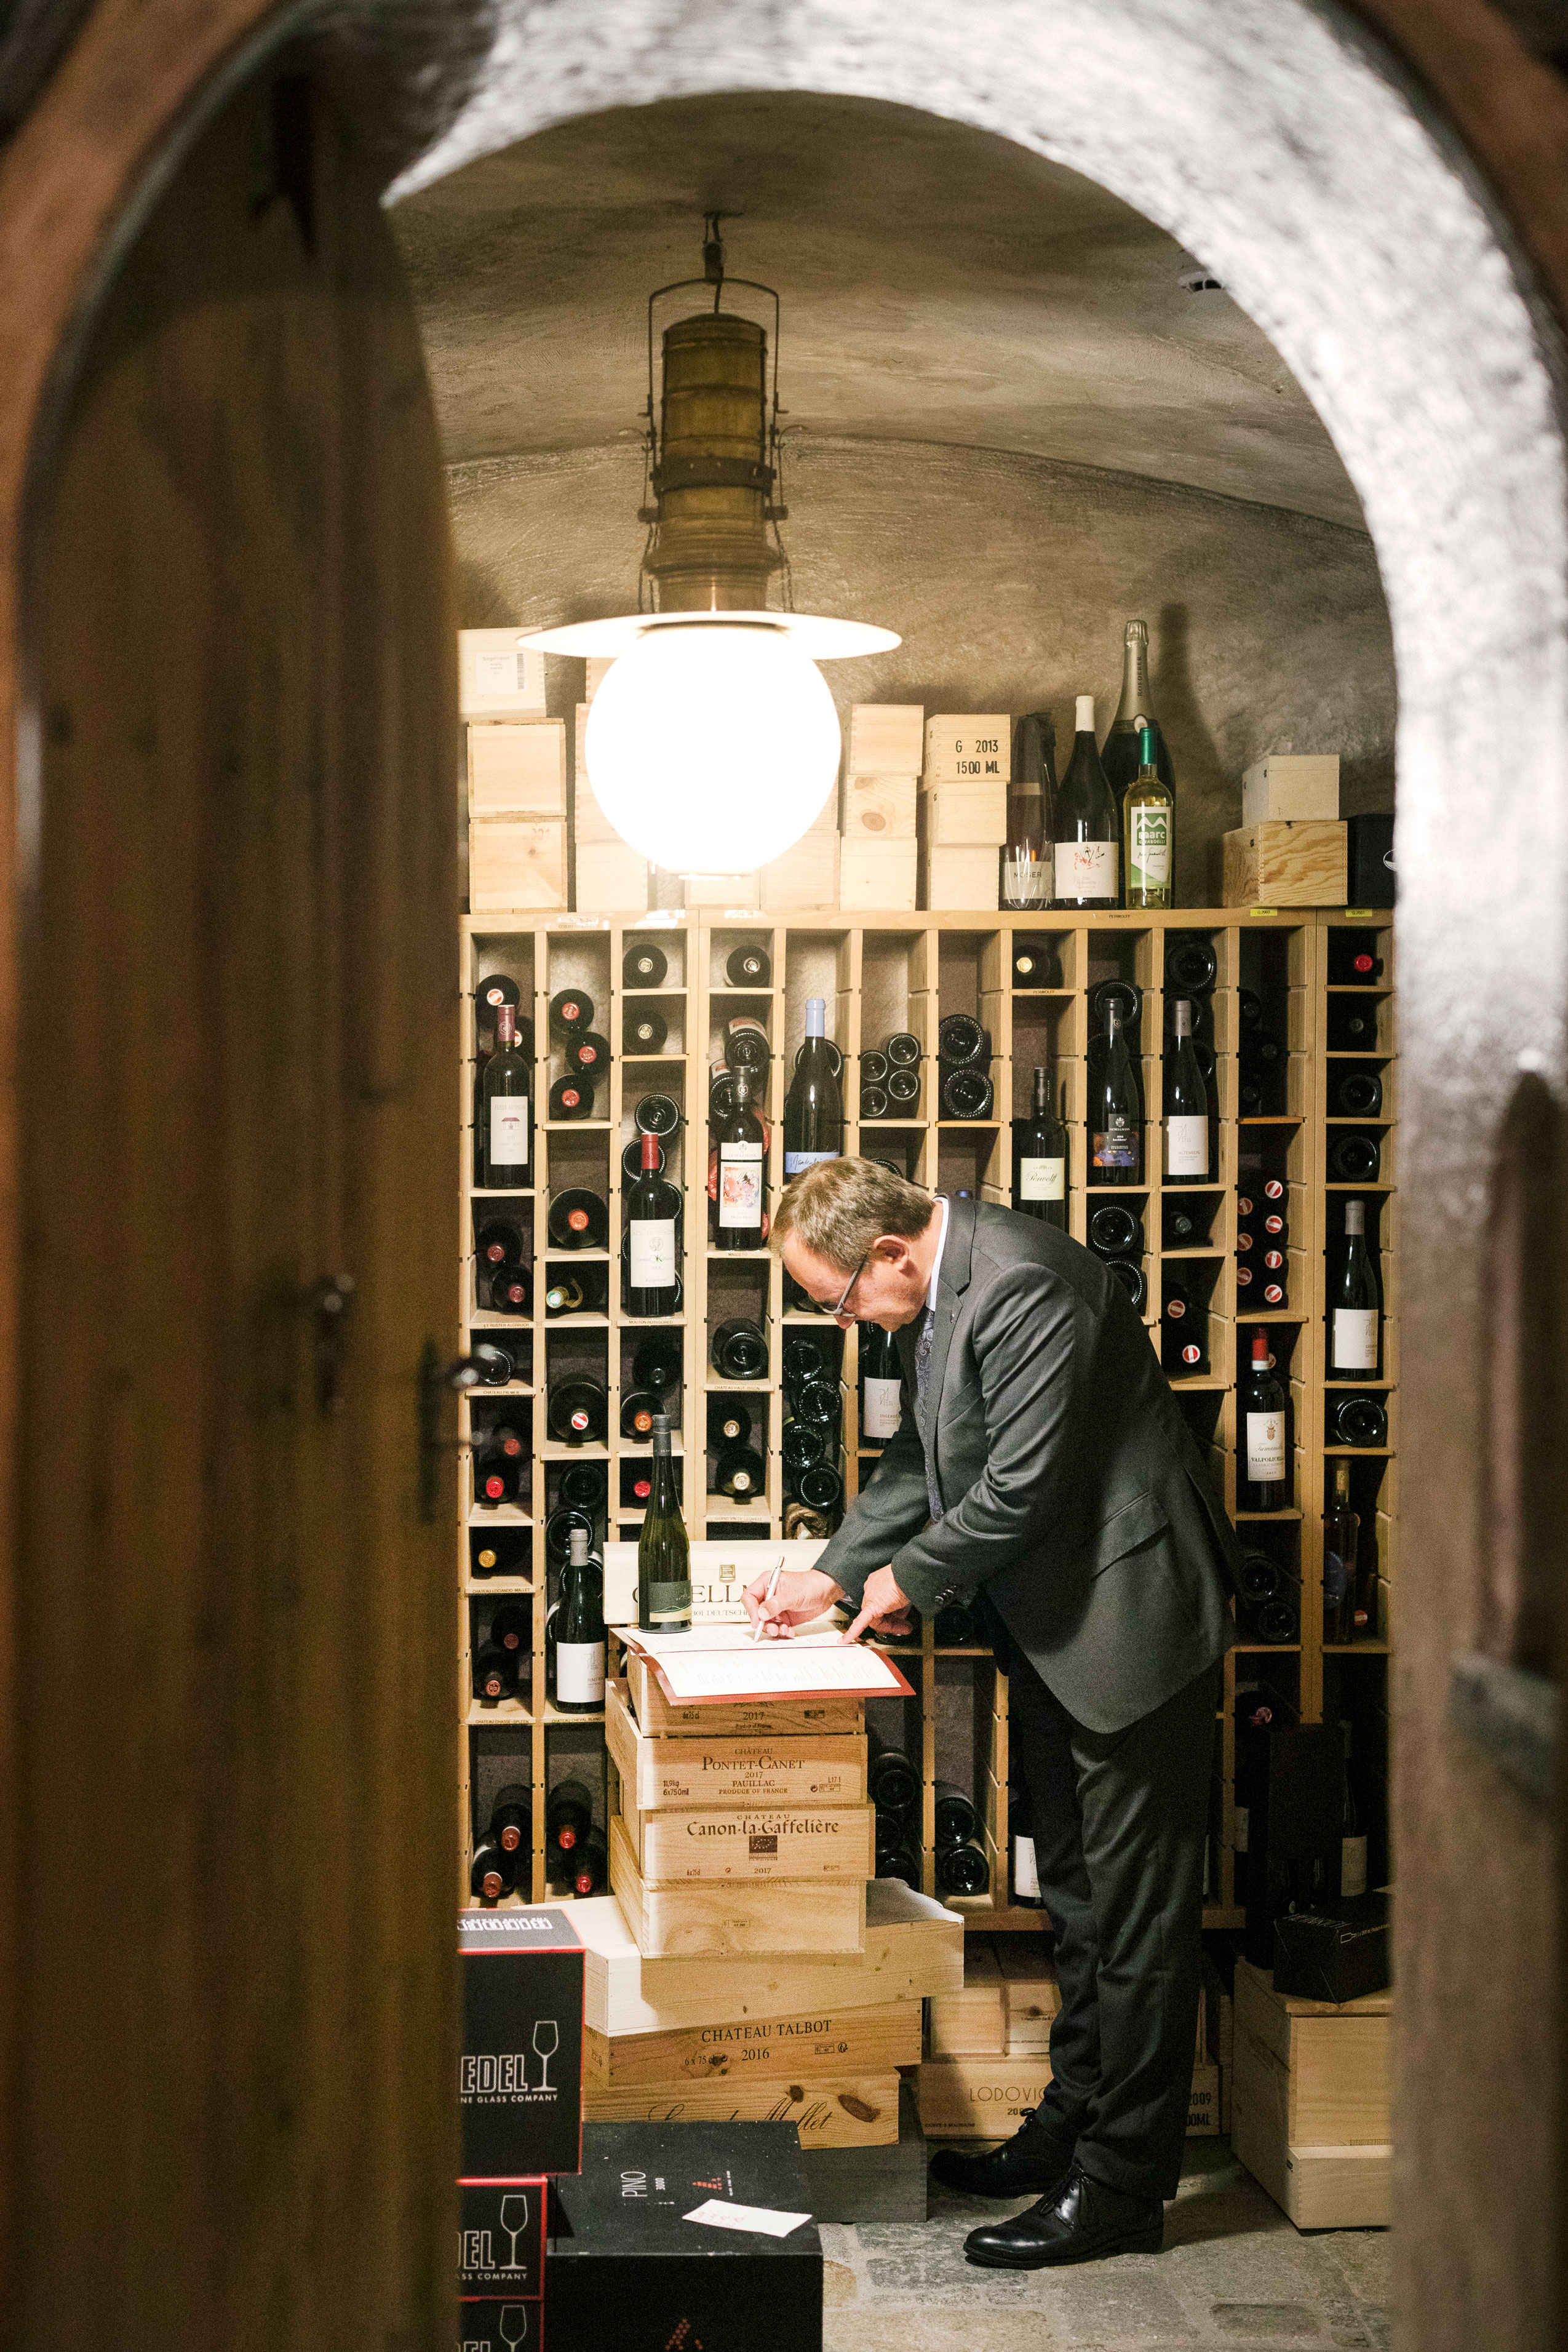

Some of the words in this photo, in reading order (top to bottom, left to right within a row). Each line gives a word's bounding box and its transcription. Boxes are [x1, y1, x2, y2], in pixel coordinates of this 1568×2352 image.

[955, 740, 963, 753] G
[976, 739, 998, 753] 2013
[956, 761, 981, 775] 1500
[985, 760, 1000, 774] ML
[1026, 1171, 1057, 1184] Perwolff
[743, 1712, 765, 1720] 2017
[702, 1755, 805, 1771] PONTET-CANET
[702, 2026, 771, 2043] CHATEAU
[776, 2020, 832, 2036] TALBOT
[741, 2047, 770, 2061] 2016
[461, 2054, 528, 2093] EDEL
[511, 2094, 558, 2103] COMPANY
[969, 2086, 1046, 2102] LODOVIC
[655, 2177, 666, 2190] 3000
